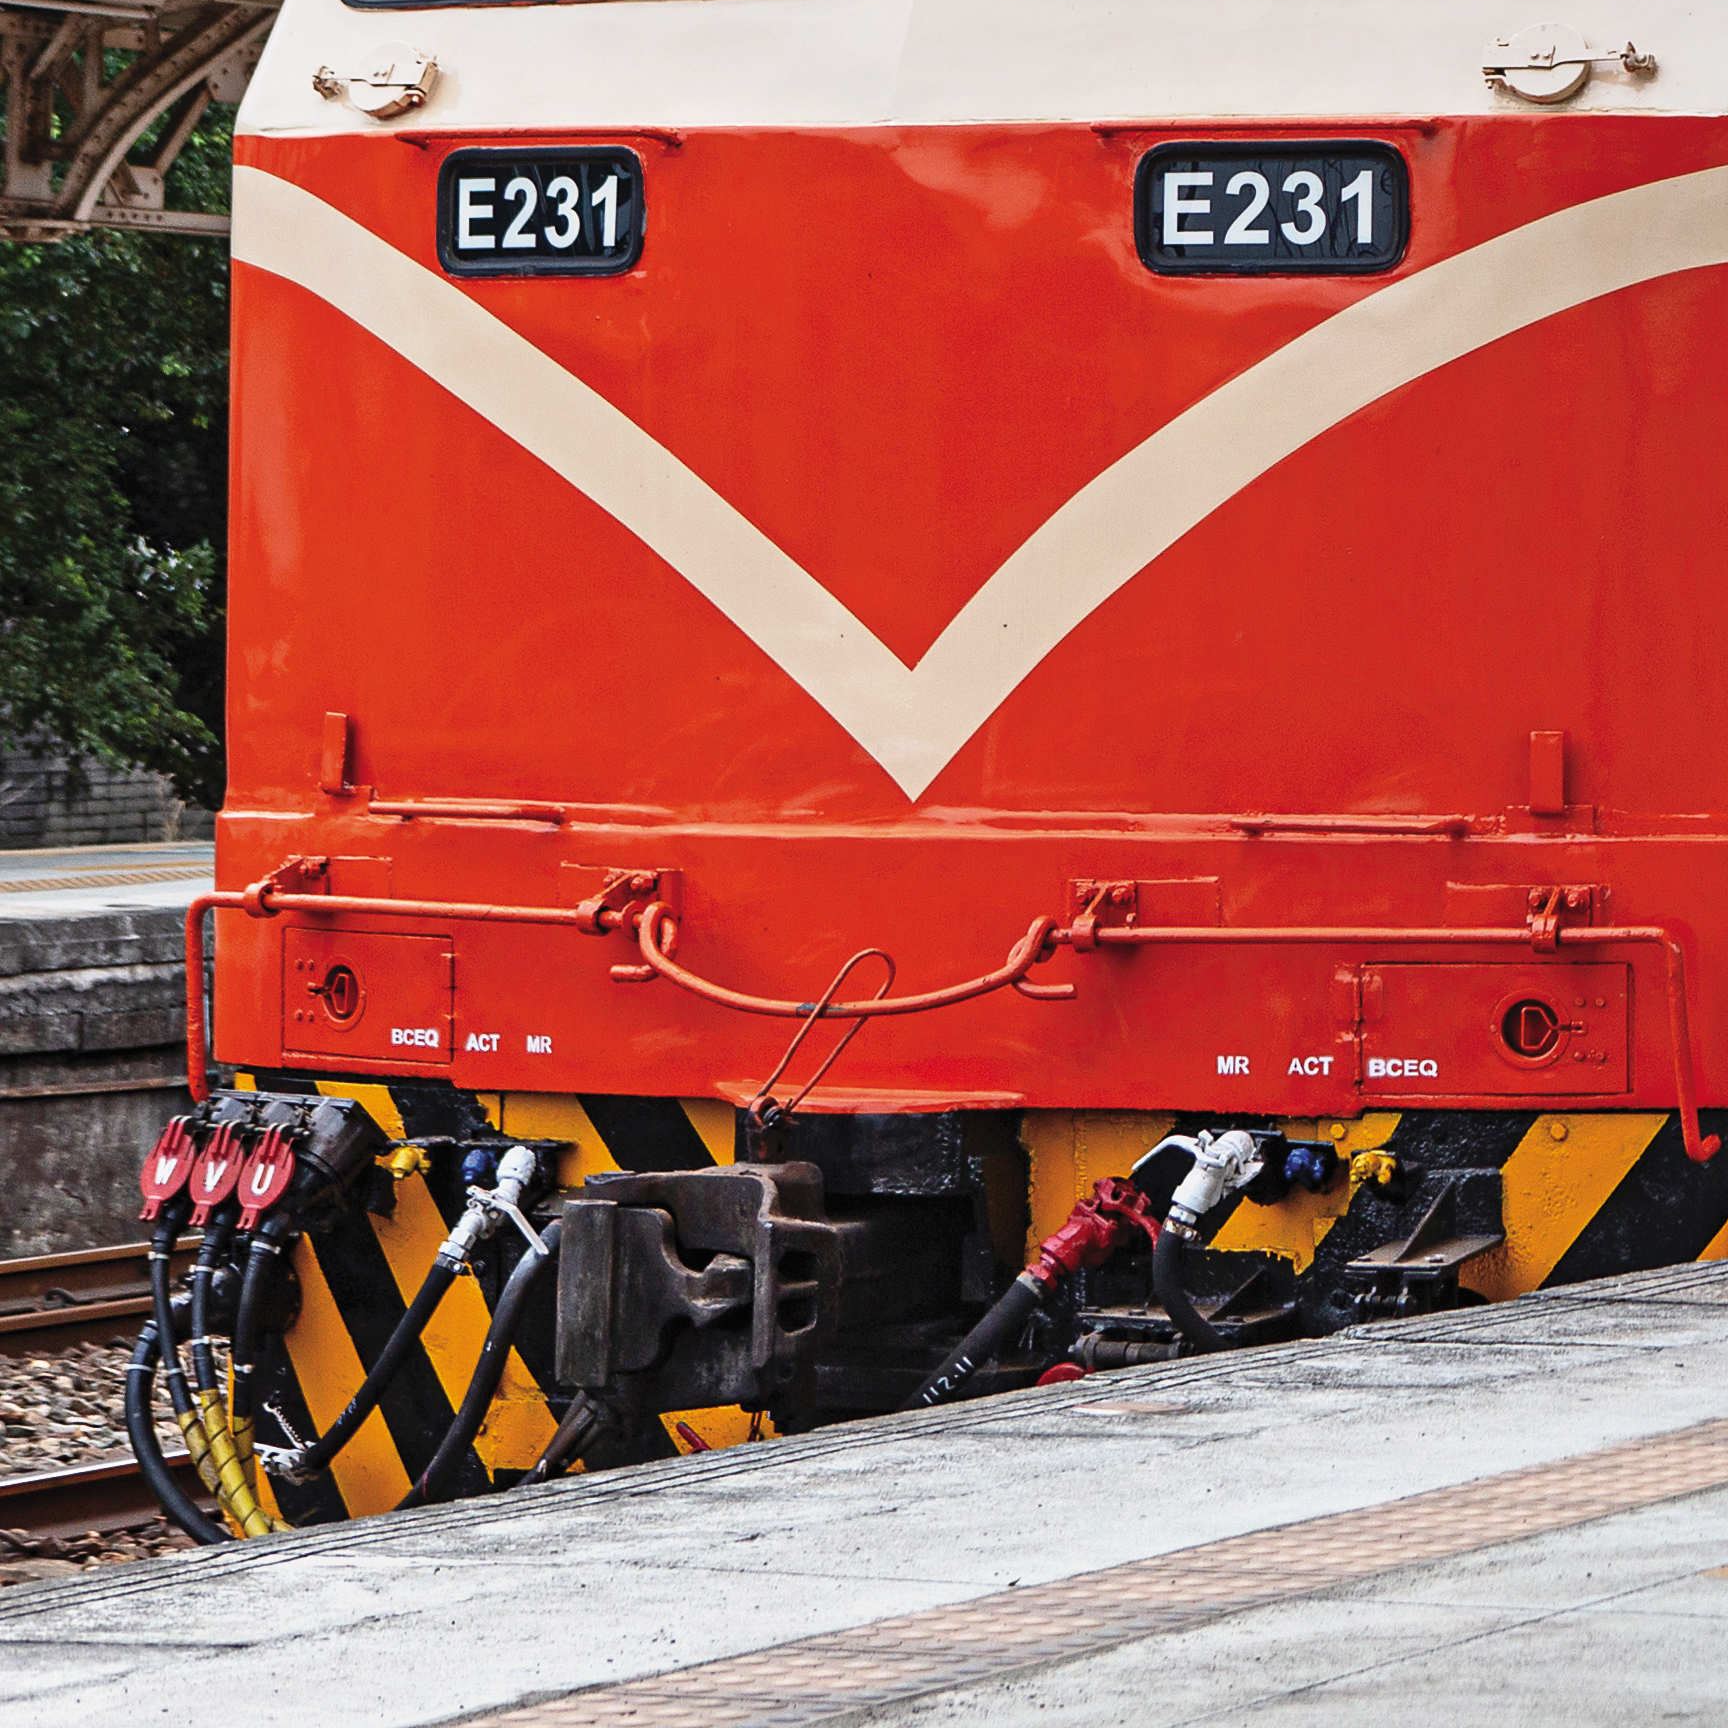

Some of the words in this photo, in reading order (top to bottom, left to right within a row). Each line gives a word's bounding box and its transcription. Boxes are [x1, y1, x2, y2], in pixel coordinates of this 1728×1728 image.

[457, 175, 618, 249] E231
[1162, 170, 1374, 246] E231
[391, 1027, 439, 1048] BCEQ
[466, 1033, 500, 1052] ACT
[527, 1035, 552, 1054] MR
[1217, 1055, 1250, 1075] MR
[1288, 1056, 1334, 1075] ACT
[1368, 1058, 1438, 1077] BCEQ
[155, 1156, 178, 1185] W
[205, 1161, 227, 1192] V
[251, 1163, 275, 1195] U
